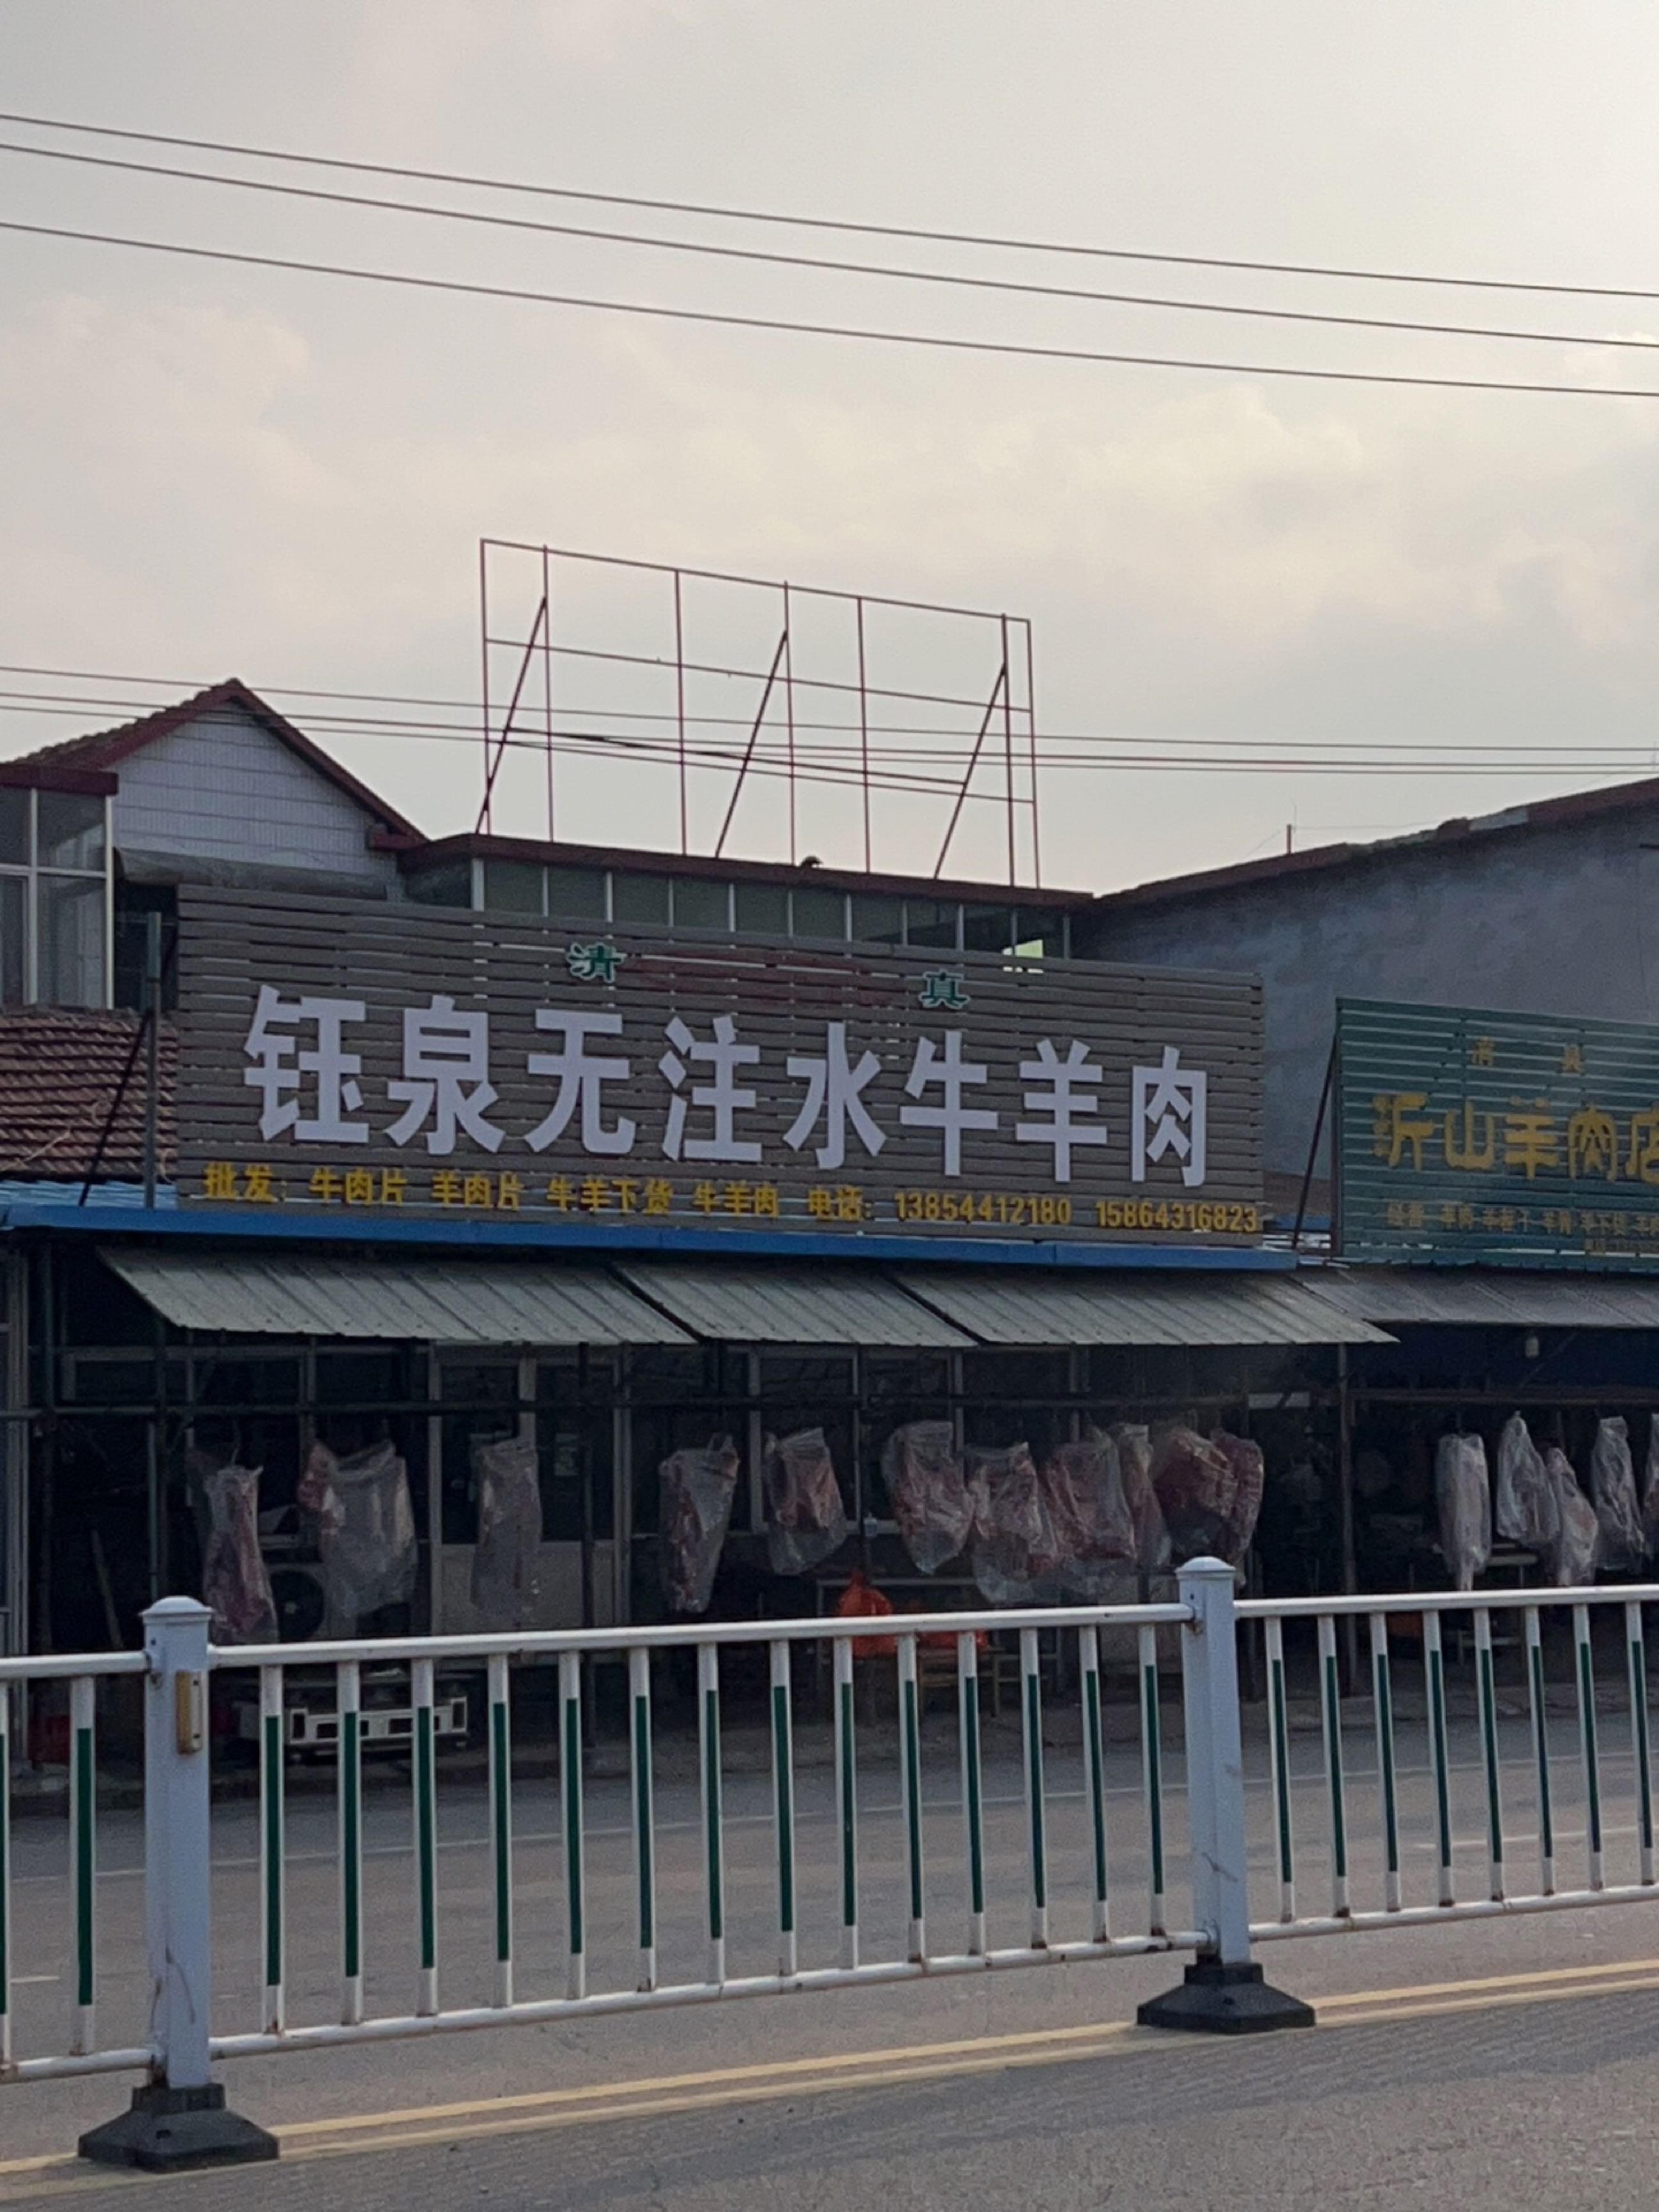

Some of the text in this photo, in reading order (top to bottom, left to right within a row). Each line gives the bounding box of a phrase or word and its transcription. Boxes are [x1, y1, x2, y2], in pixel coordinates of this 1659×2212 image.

[566, 942, 971, 1010] 清 真
[244, 984, 1207, 1188] 钰泉无注水牛羊肉
[309, 1166, 408, 1206] 牛肉片
[431, 1169, 524, 1212] 羊肉片
[546, 1174, 673, 1217] 牛羊下货
[693, 1180, 779, 1219] 牛羊肉
[894, 1190, 1072, 1225] 13854412180
[1095, 1199, 1257, 1233] 15864316823
